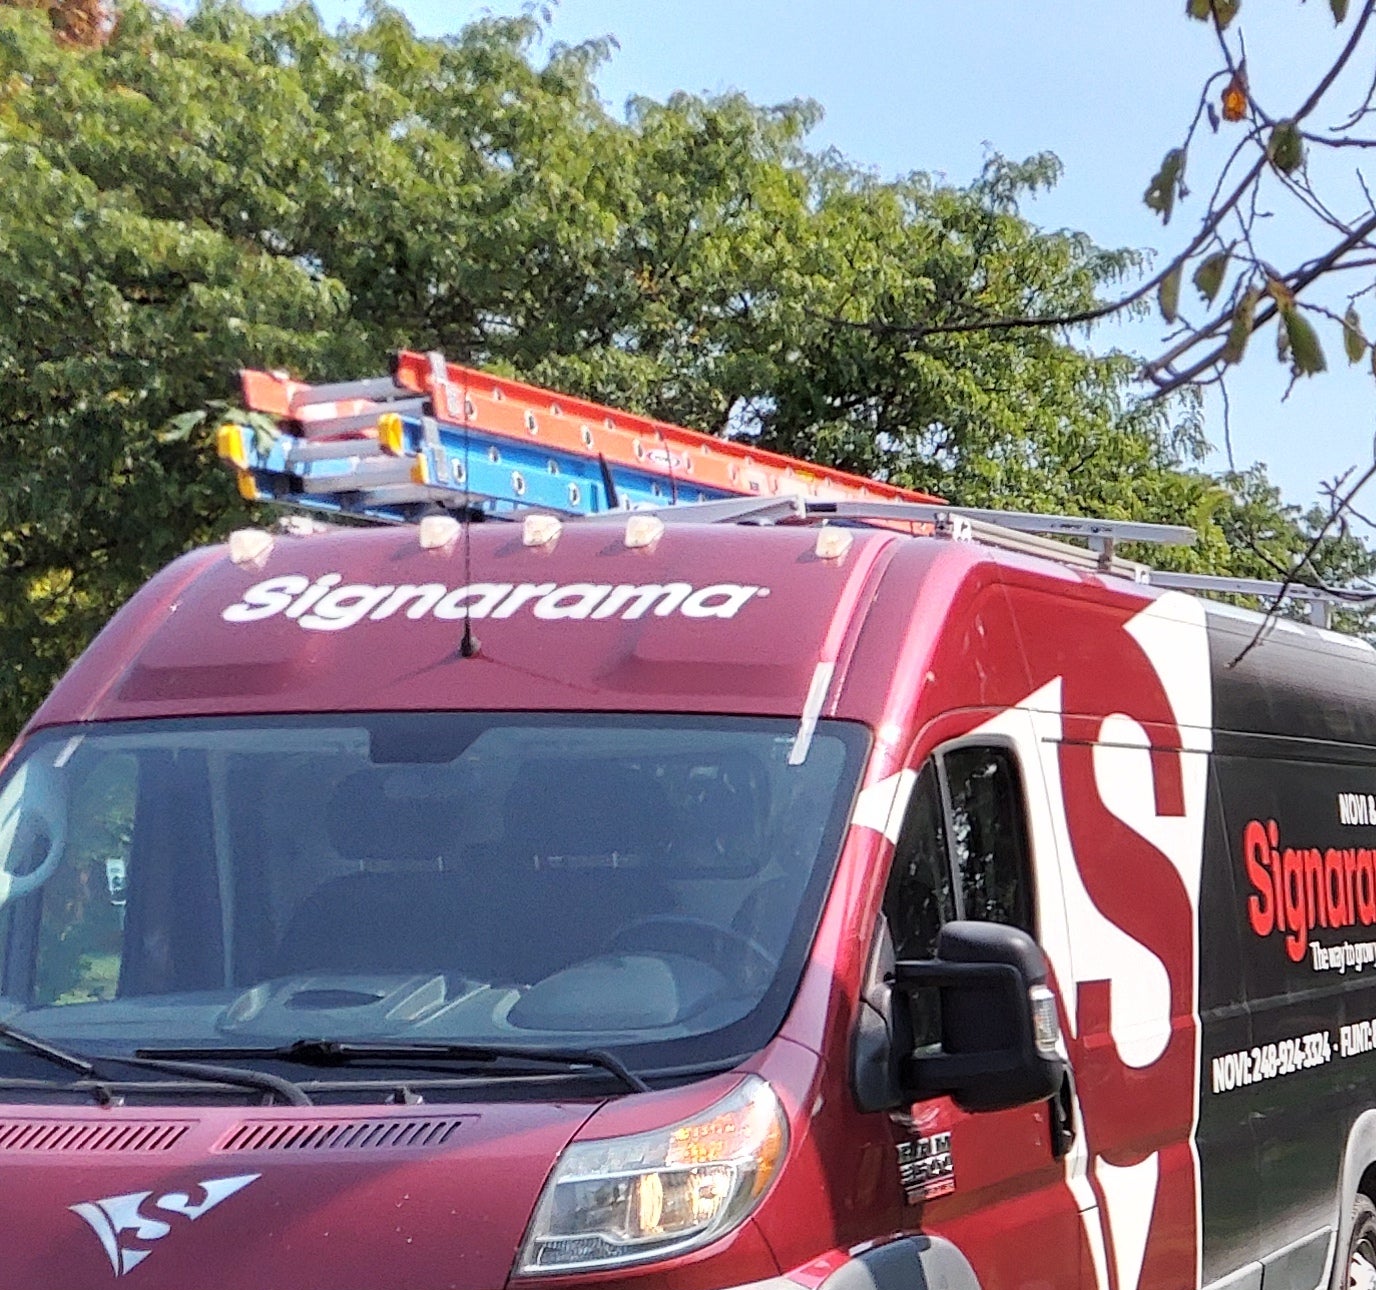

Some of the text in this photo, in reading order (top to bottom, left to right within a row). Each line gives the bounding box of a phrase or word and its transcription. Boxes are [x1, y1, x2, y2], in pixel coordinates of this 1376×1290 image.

[222, 573, 771, 632] Signarama
[1339, 793, 1369, 826] NOVI
[1308, 941, 1329, 971] The
[1251, 1031, 1331, 1083] 248-924-3324
